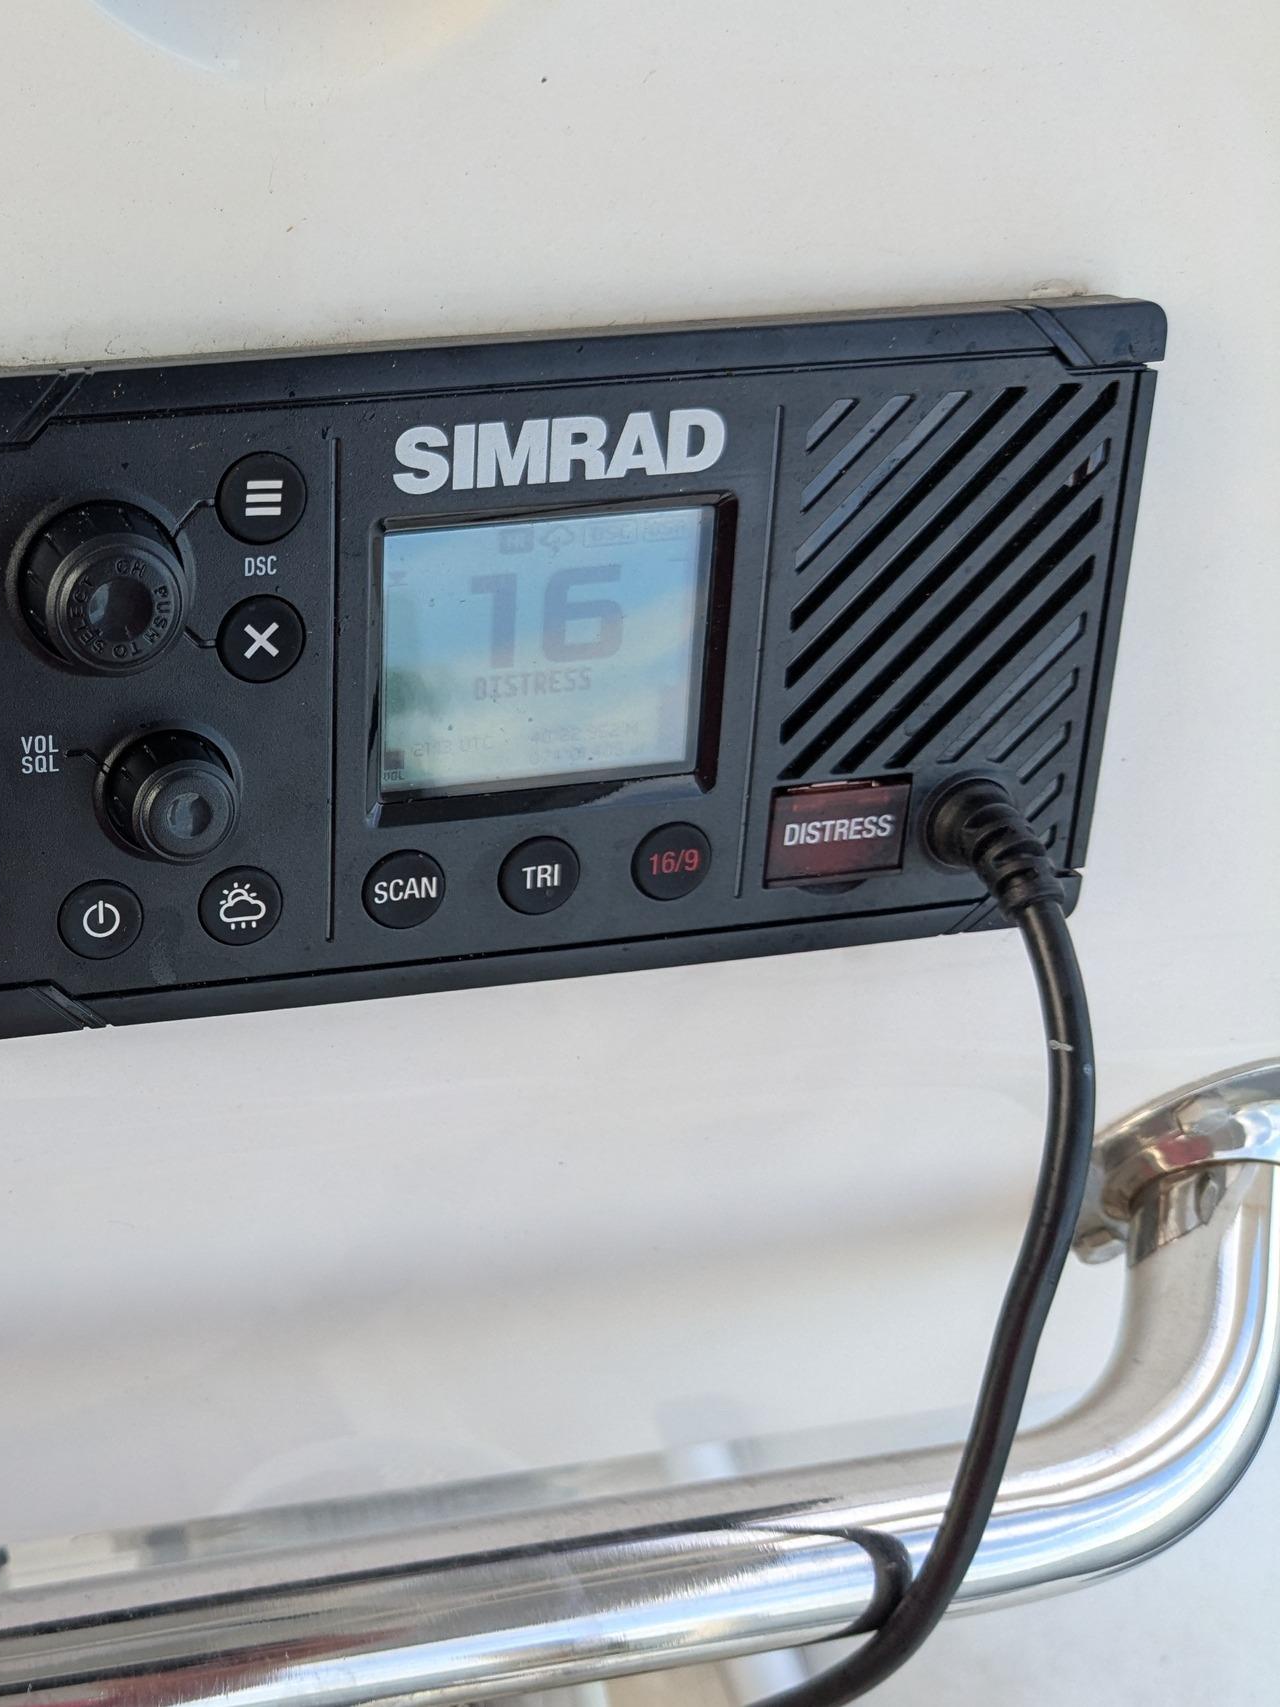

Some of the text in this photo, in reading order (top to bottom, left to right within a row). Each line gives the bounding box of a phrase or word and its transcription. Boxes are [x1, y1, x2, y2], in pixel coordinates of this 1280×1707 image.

[393, 408, 725, 495] SIMRAD
[114, 559, 146, 578] CH
[244, 556, 277, 577] DSC
[70, 575, 171, 659] PUSH TO SELECT
[470, 563, 624, 669] 16
[474, 667, 592, 701] DISTRESS
[21, 735, 59, 754] VOL
[21, 755, 60, 774] SQL
[383, 771, 406, 782] VOL
[783, 814, 895, 847] DISTRESS
[649, 849, 700, 876] 16/9
[522, 863, 560, 890] TRI
[374, 876, 438, 905] SCAN
